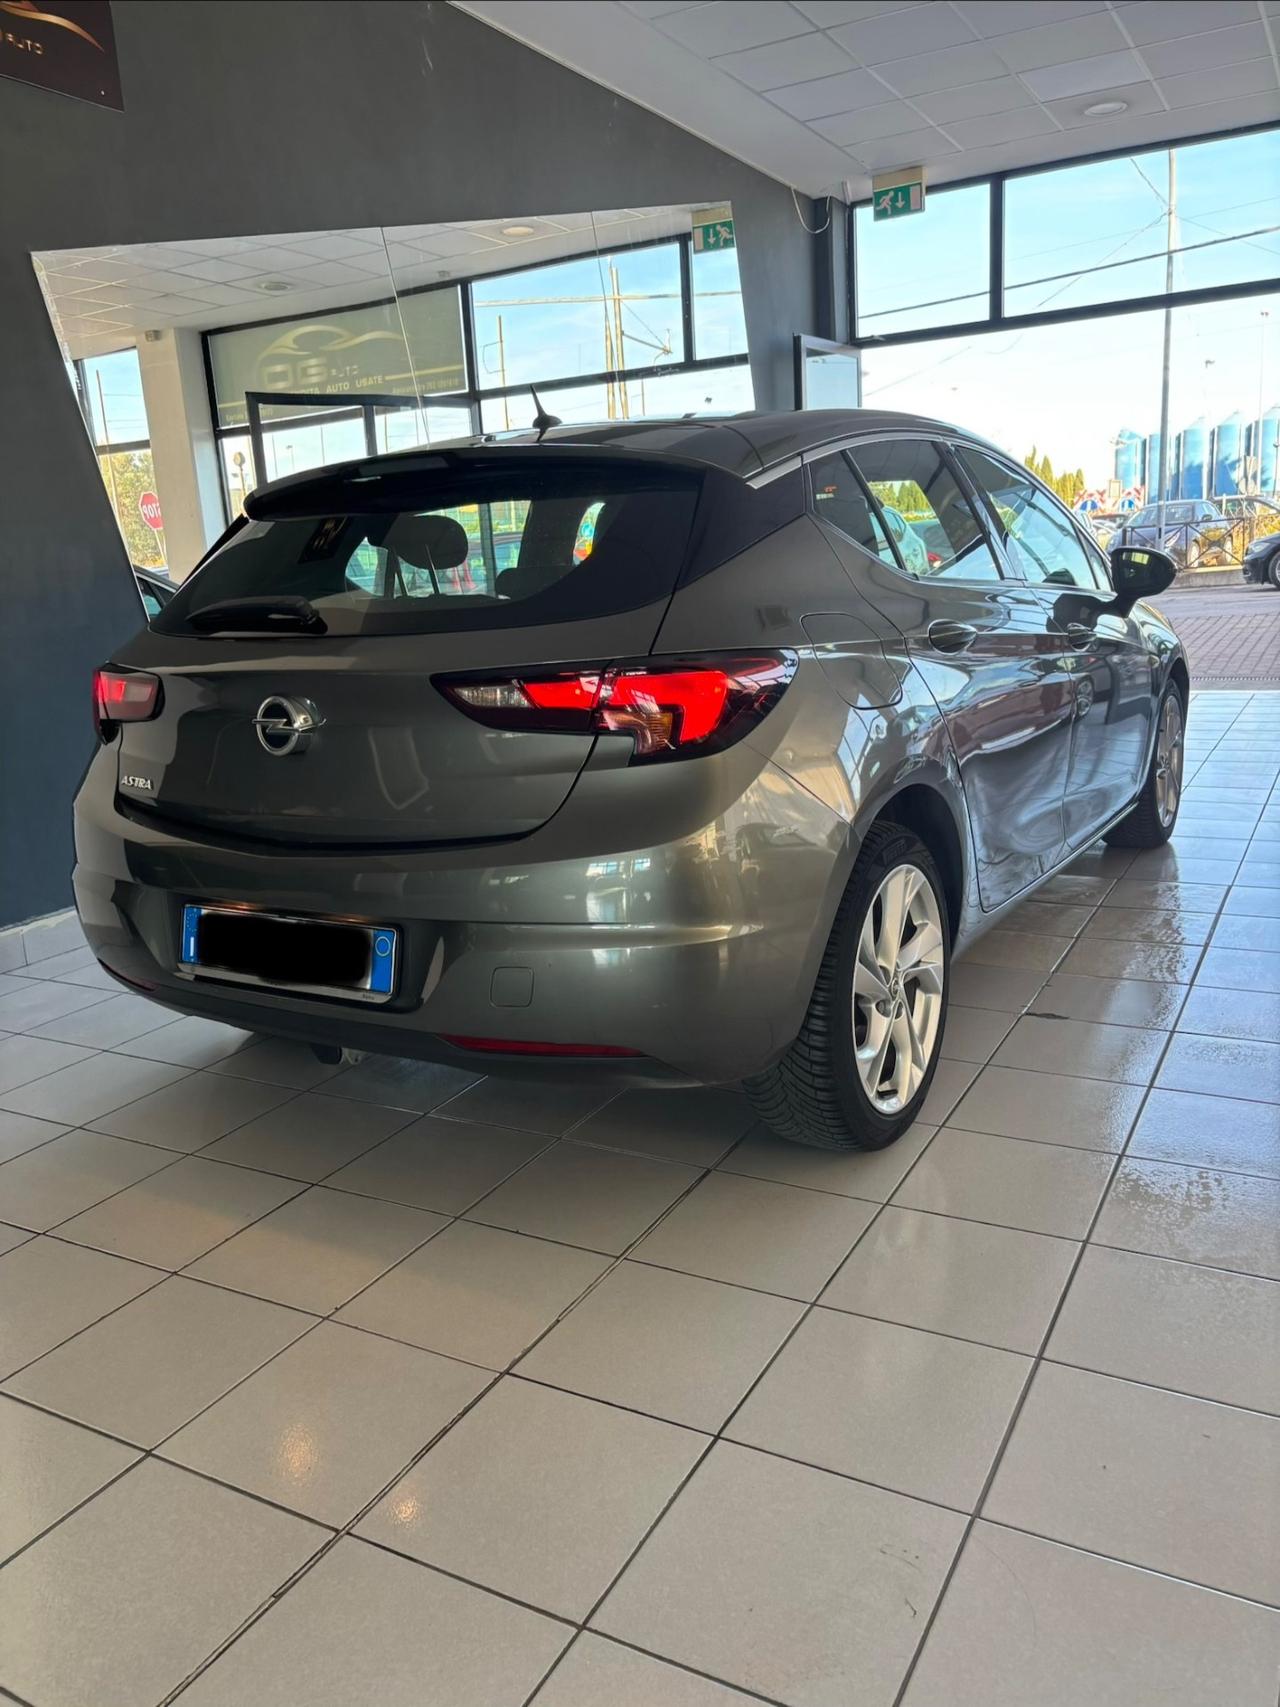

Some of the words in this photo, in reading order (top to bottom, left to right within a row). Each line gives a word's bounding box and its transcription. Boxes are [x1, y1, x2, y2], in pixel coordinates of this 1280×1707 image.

[326, 382, 350, 393] AUTO
[356, 375, 383, 388] USATE
[121, 775, 152, 790] ASTRA
